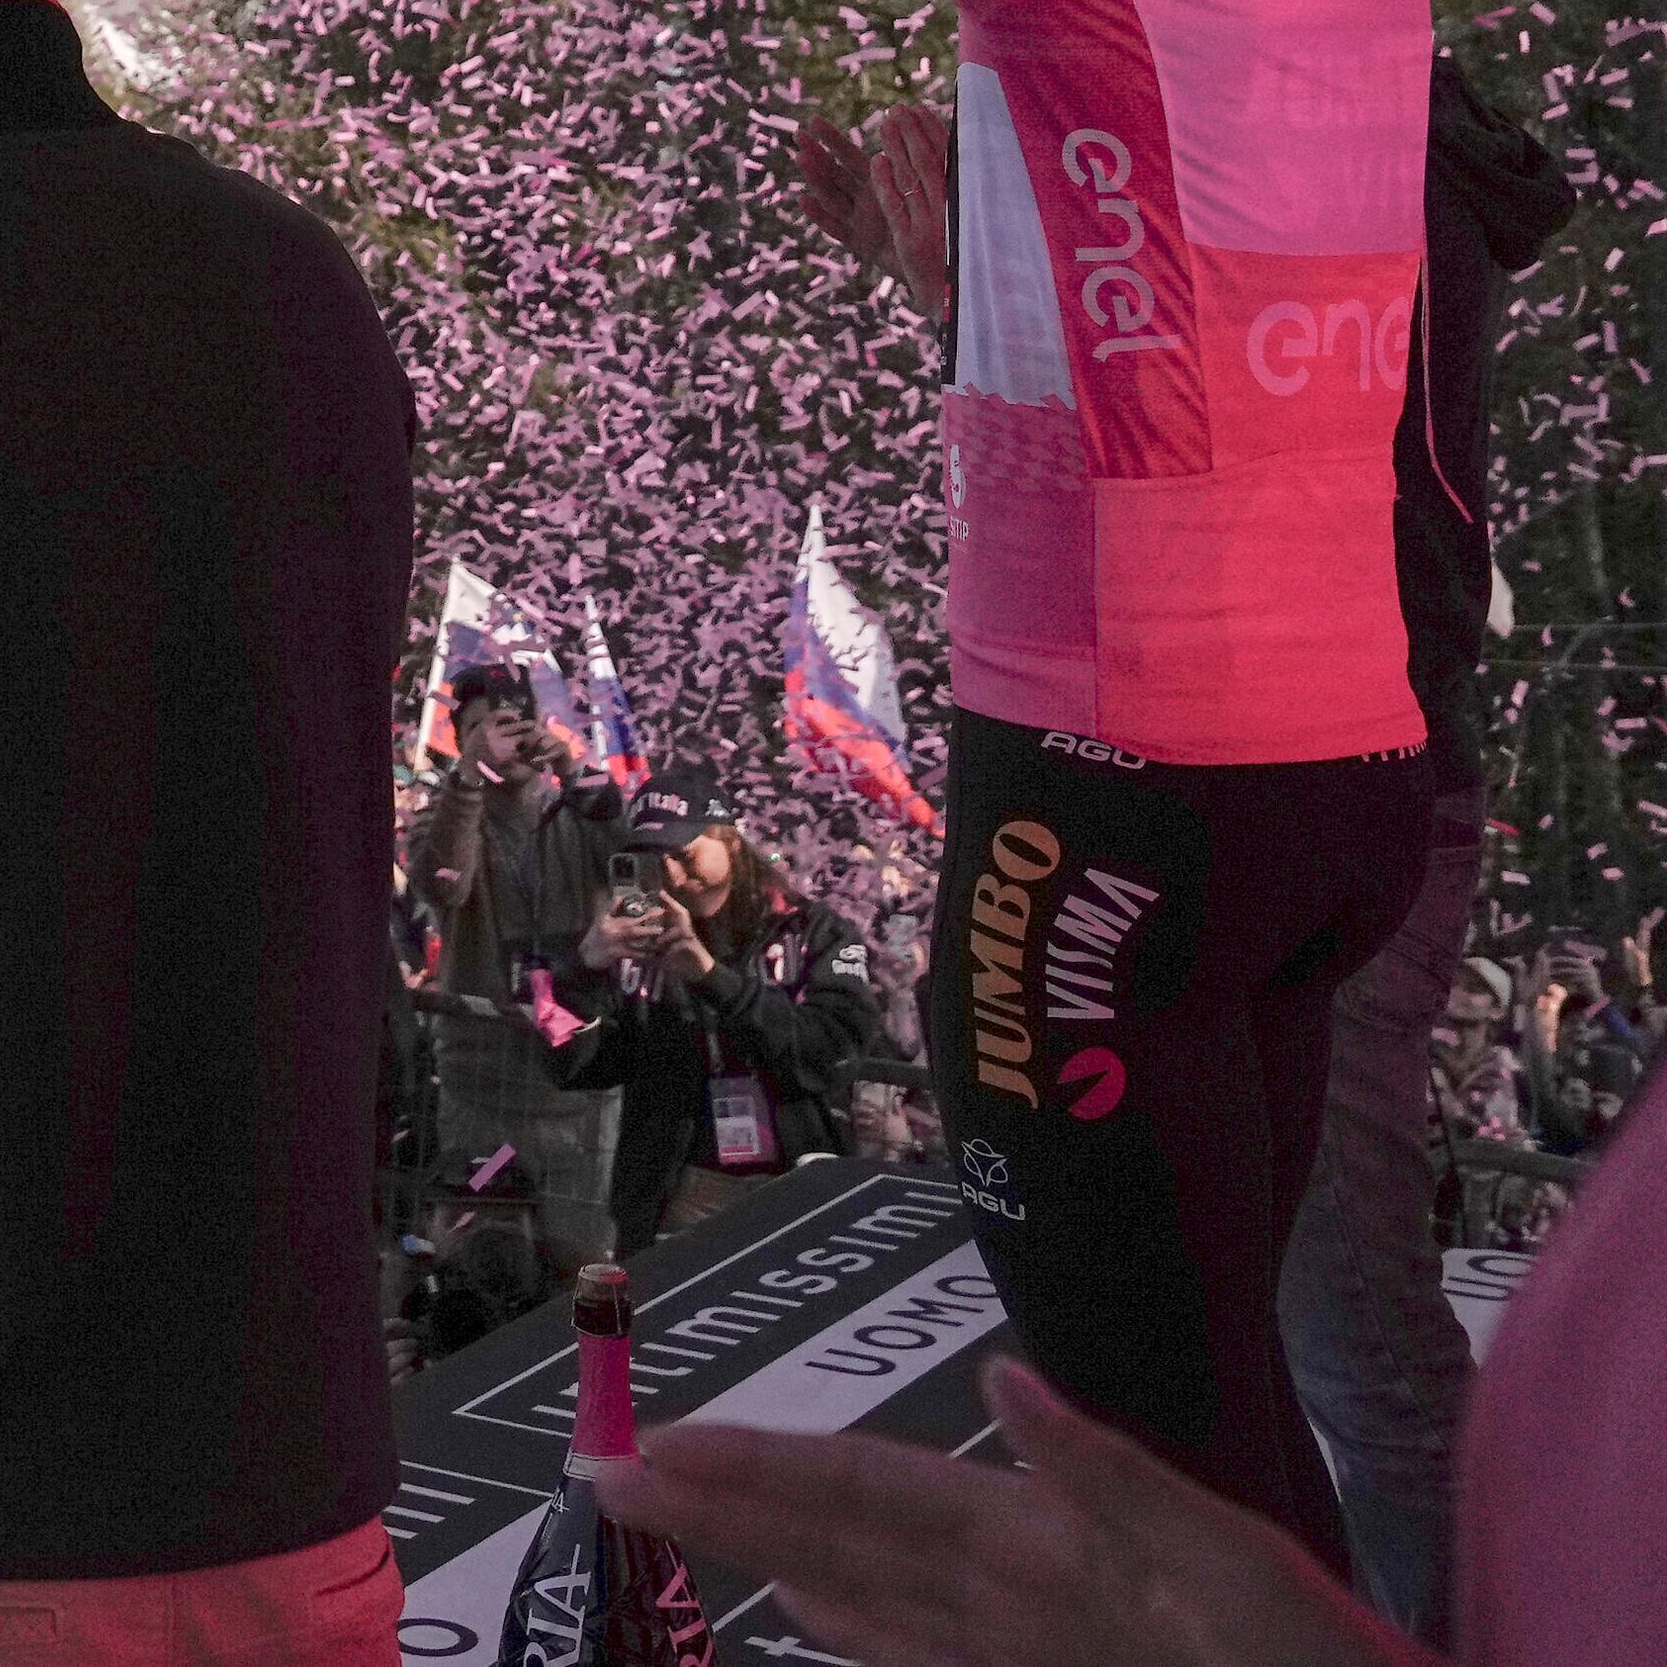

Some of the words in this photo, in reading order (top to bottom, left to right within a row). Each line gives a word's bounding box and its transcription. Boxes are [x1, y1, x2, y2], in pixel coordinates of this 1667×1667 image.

[1062, 128, 1182, 363] enel
[1246, 296, 1411, 397] ene
[1040, 731, 1147, 770] AGU
[970, 820, 1061, 1110] JUMBO
[1045, 867, 1160, 1019] VISMA
[961, 1181, 1026, 1221] AGU
[805, 1275, 1002, 1378] UOMO
